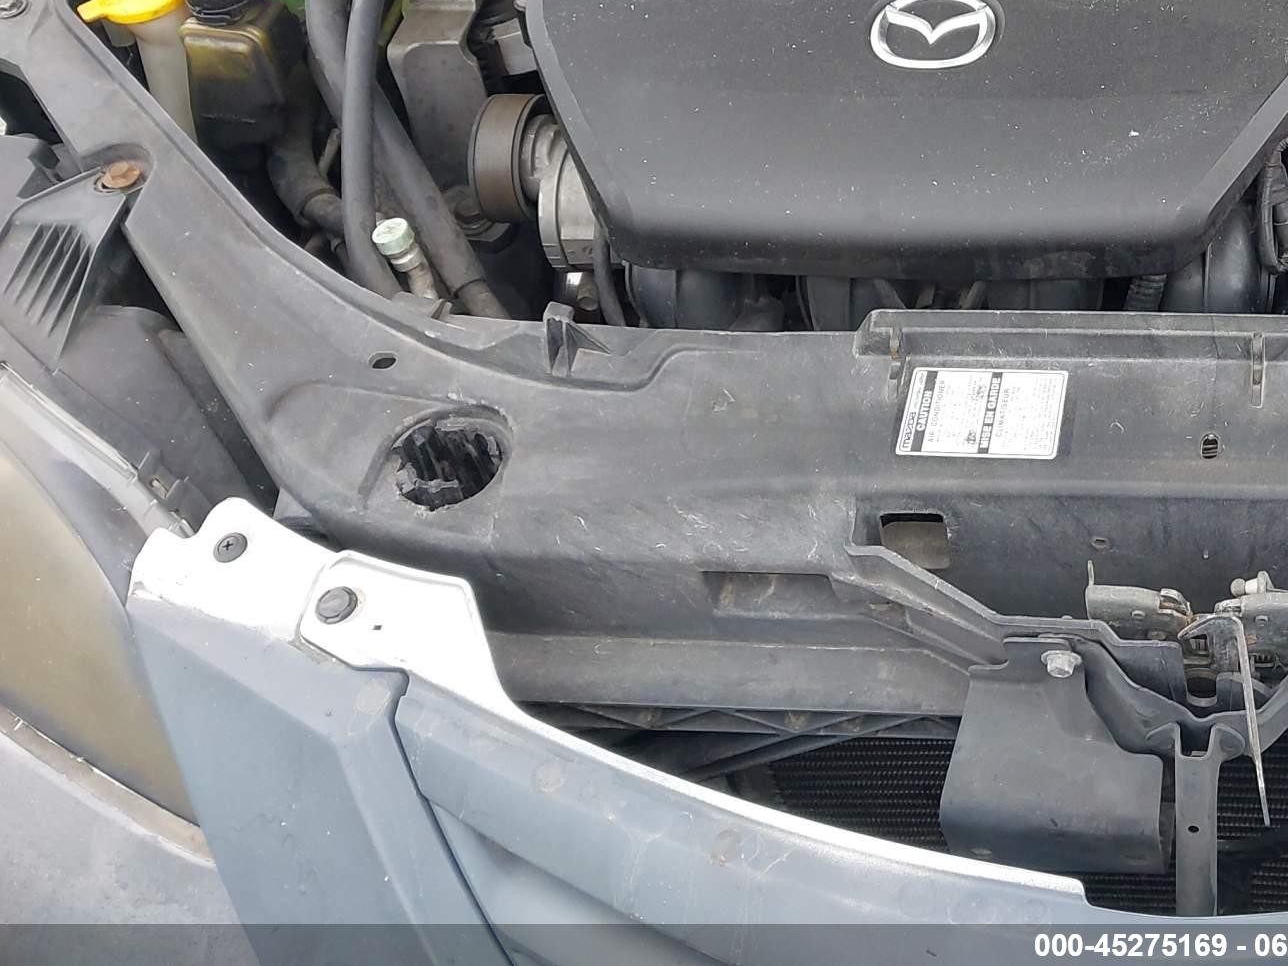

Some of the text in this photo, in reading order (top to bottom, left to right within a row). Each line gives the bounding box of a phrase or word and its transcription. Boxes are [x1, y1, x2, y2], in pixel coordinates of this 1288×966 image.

[915, 390, 933, 432] CAUTION
[931, 380, 946, 427] CONDITIONER
[979, 377, 1001, 449] MISE EN GARDE
